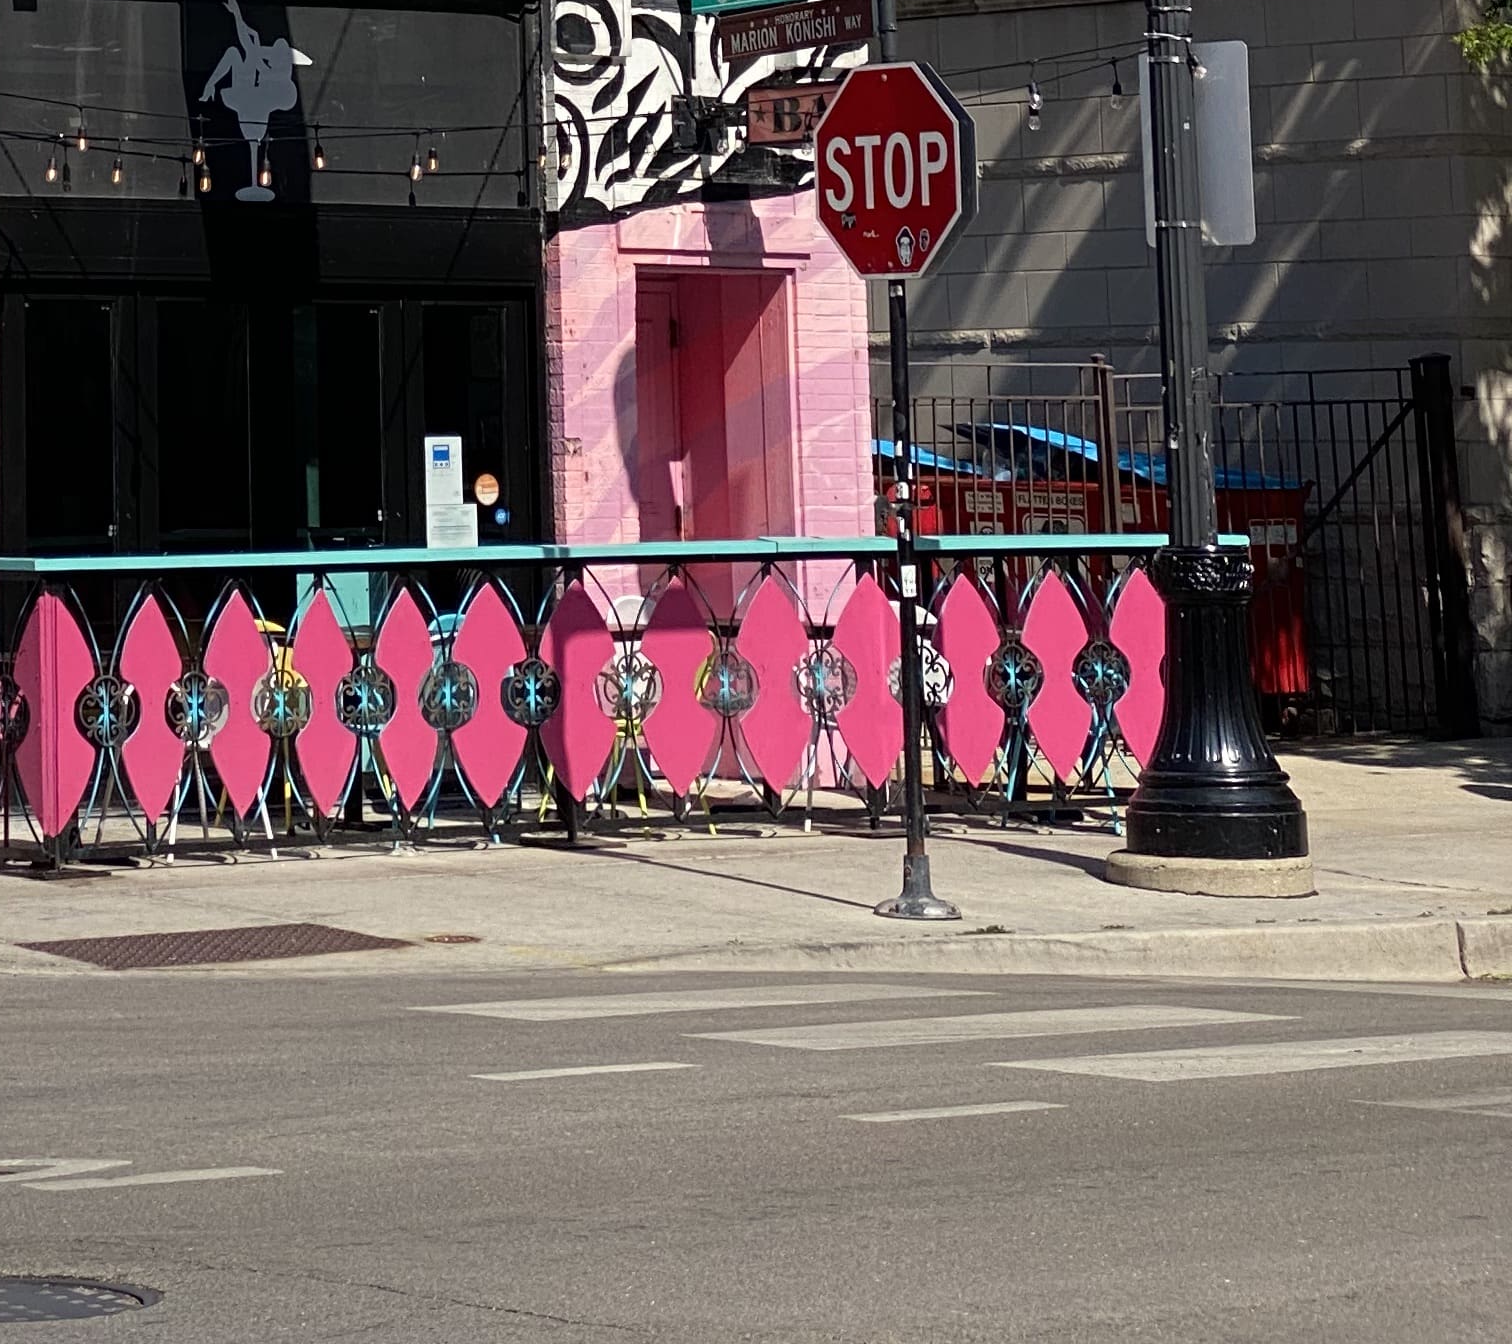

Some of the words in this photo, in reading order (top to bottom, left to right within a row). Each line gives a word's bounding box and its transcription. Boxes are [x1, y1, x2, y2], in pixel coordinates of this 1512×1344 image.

[731, 26, 779, 54] MARION
[785, 15, 837, 45] KONISHI
[844, 14, 863, 30] WAY
[774, 9, 814, 25] HONORARY
[825, 130, 948, 211] STOP
